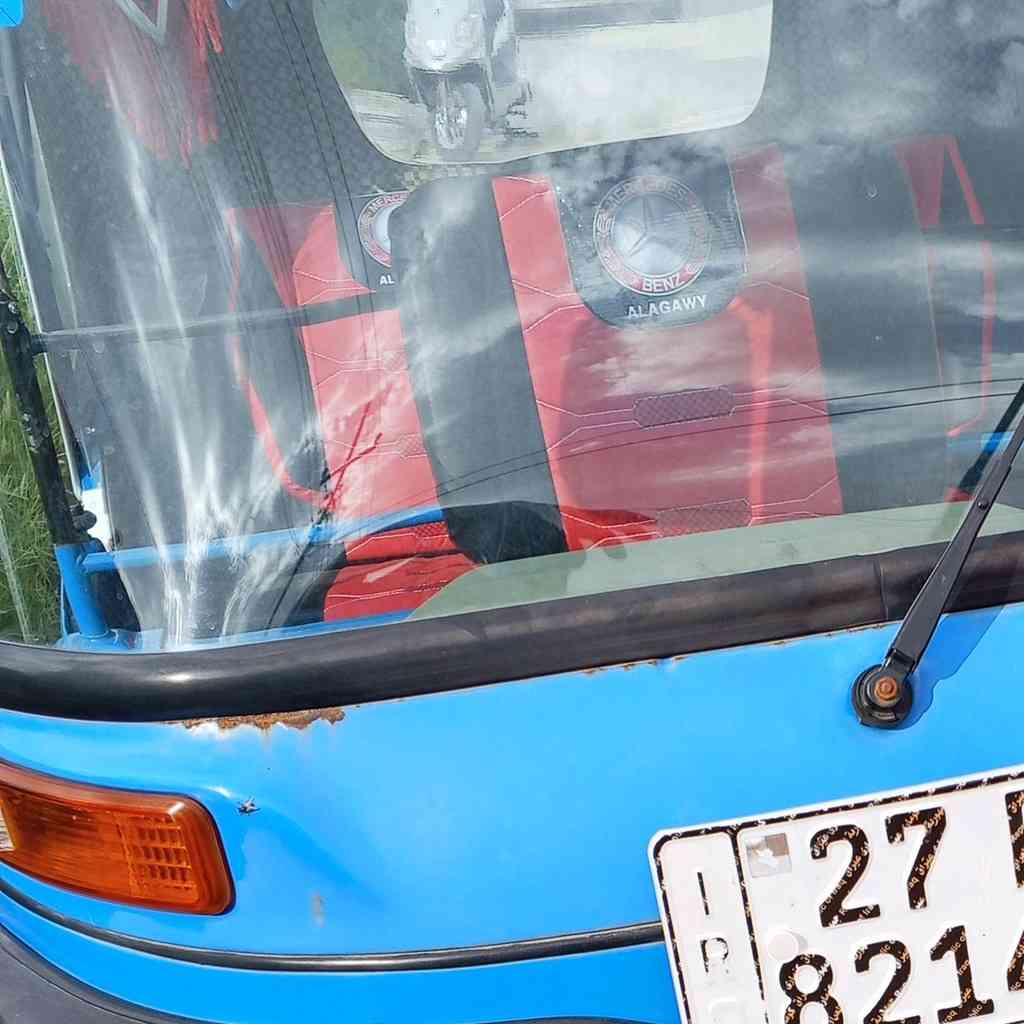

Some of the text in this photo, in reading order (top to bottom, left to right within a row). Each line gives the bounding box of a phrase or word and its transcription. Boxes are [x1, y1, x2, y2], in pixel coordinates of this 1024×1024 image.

[642, 274, 685, 292] BENZ
[626, 294, 707, 319] ALAGAWY
[810, 807, 946, 927] 27
